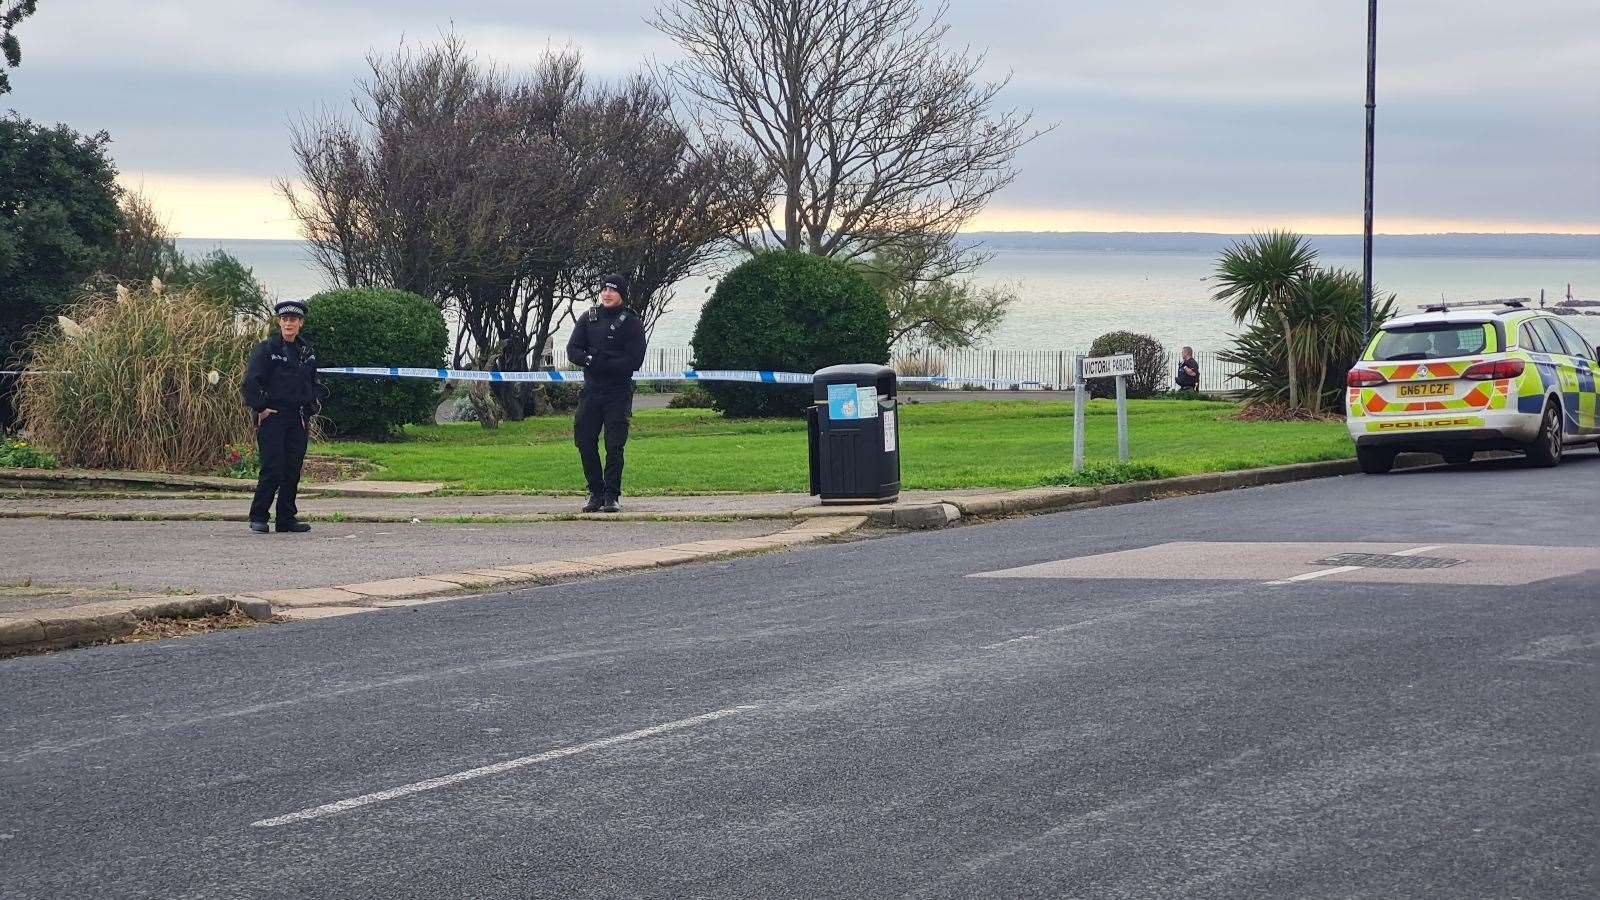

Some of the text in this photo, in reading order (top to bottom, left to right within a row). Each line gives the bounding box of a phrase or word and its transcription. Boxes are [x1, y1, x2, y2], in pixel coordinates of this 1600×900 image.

[1085, 358, 1132, 374] VICTORIA PARADE
[1400, 383, 1450, 396] GN67 CZF
[1380, 419, 1469, 428] POLICE
